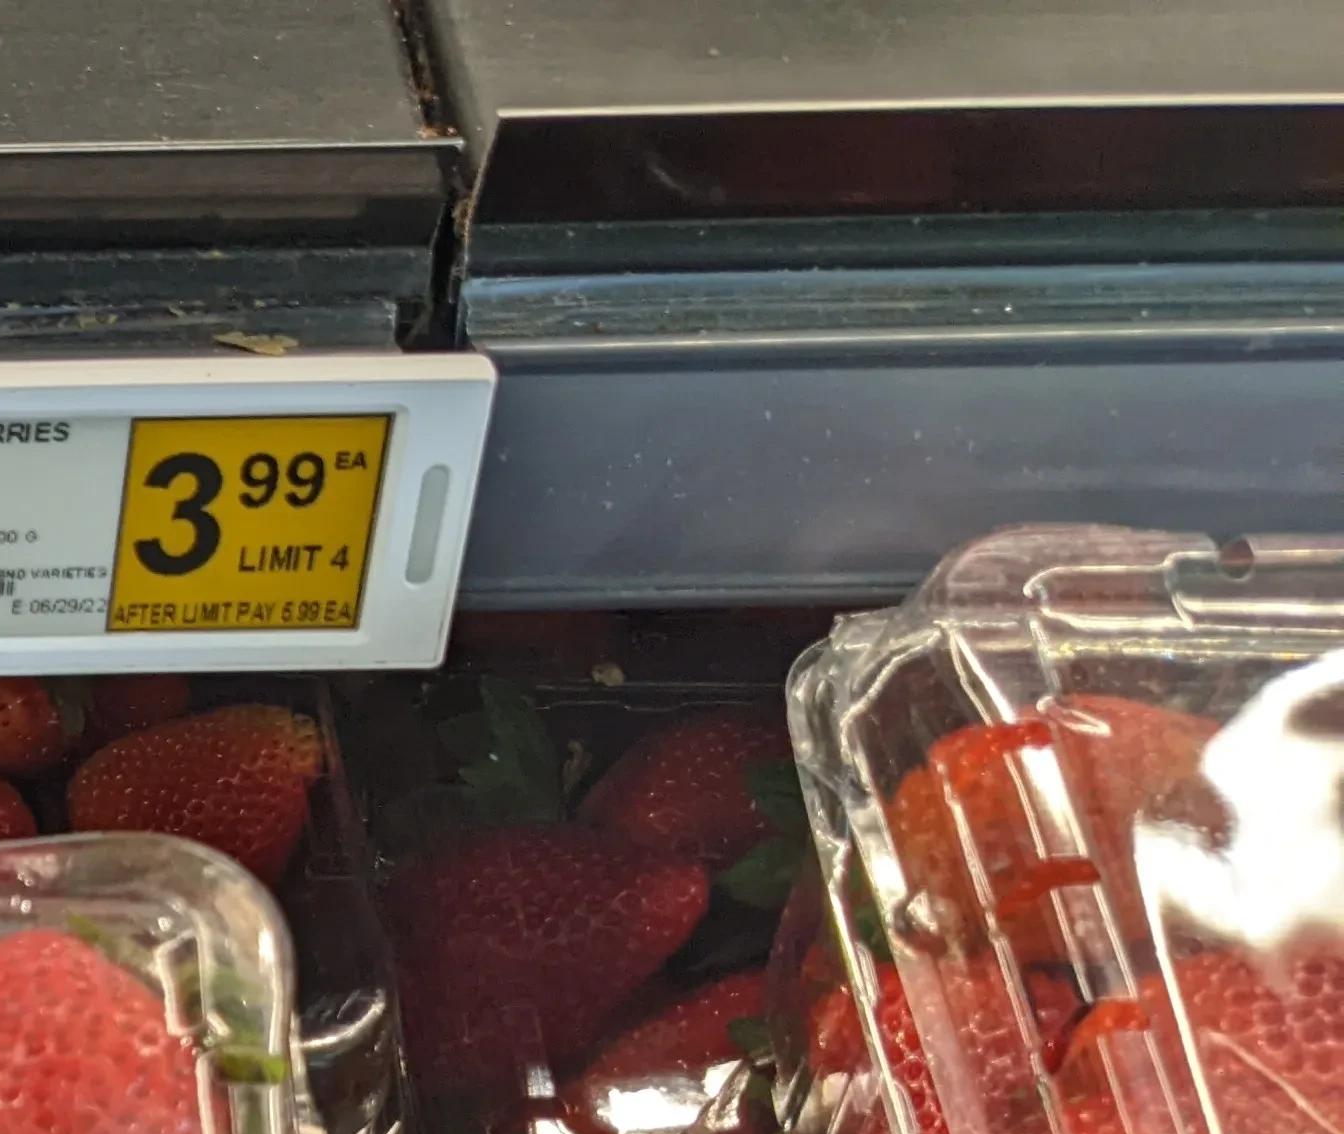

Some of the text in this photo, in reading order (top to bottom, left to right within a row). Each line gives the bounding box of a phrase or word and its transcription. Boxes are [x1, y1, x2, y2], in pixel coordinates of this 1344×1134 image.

[133, 451, 368, 577] 3 99 EA
[238, 545, 350, 572] LIMIT 4
[113, 603, 178, 625] AFTER
[181, 602, 233, 624] LIMIT
[235, 601, 277, 623] PAY
